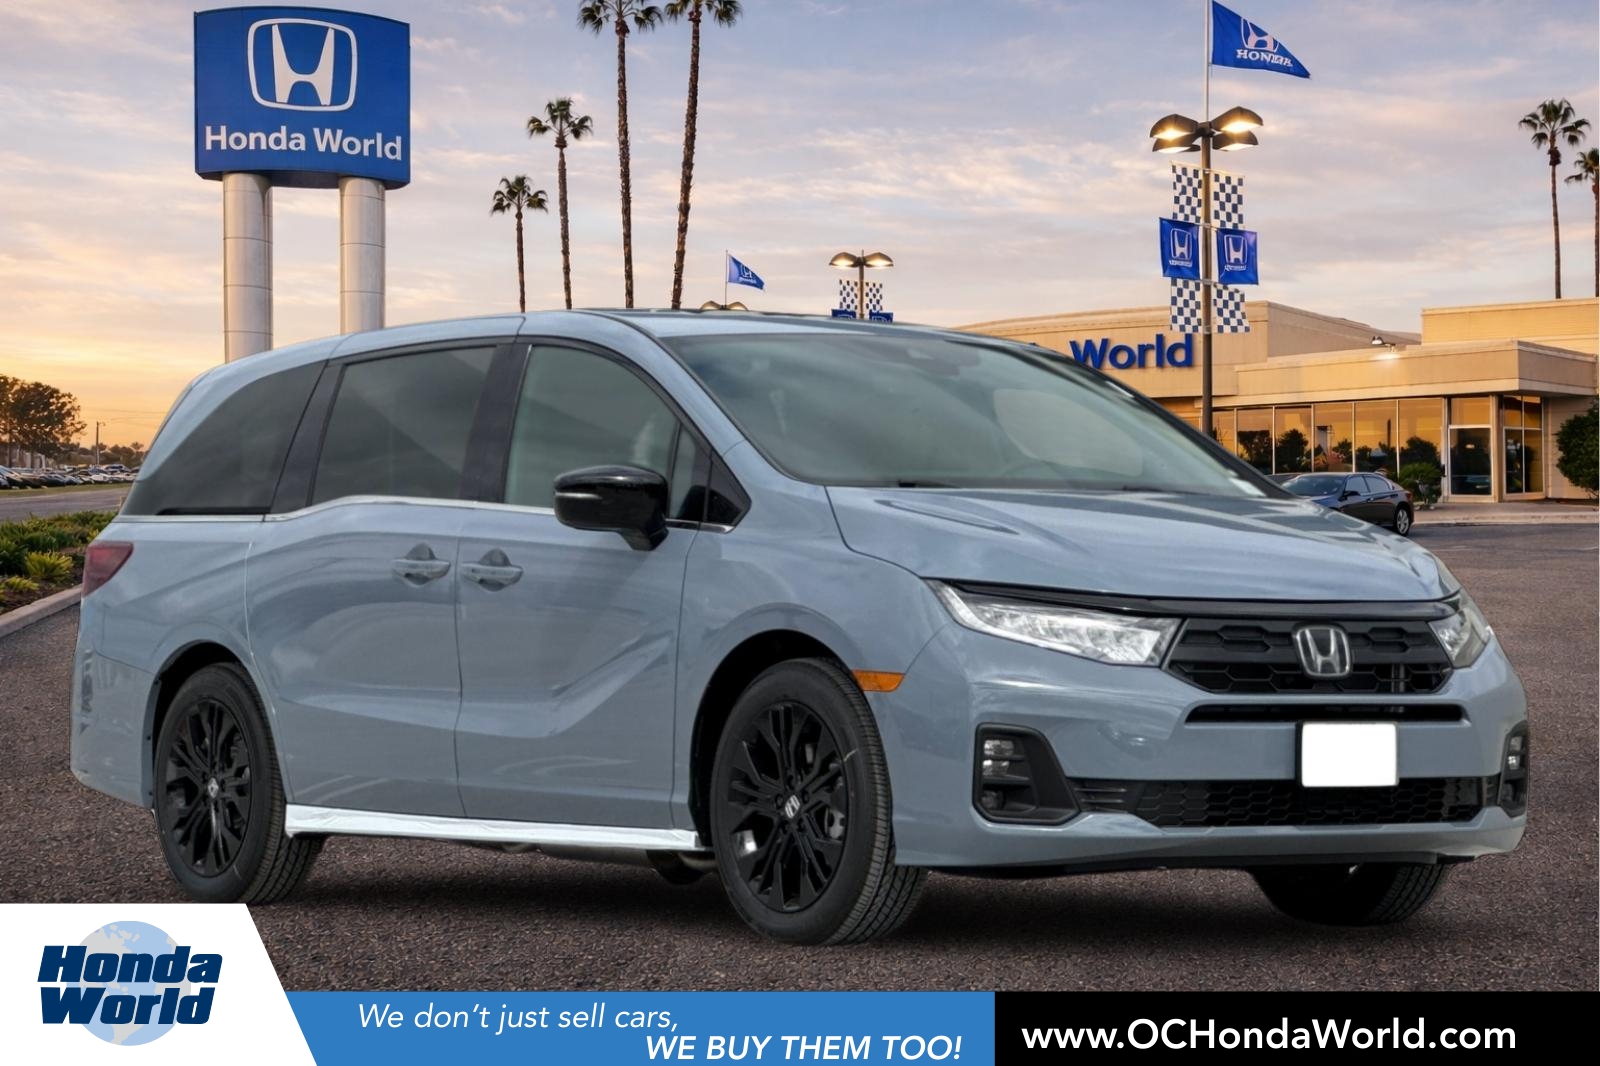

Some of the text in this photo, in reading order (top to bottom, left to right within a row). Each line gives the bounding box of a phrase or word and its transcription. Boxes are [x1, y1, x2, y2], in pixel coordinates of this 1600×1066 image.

[205, 125, 402, 161] Honda World
[1066, 331, 1194, 370] World
